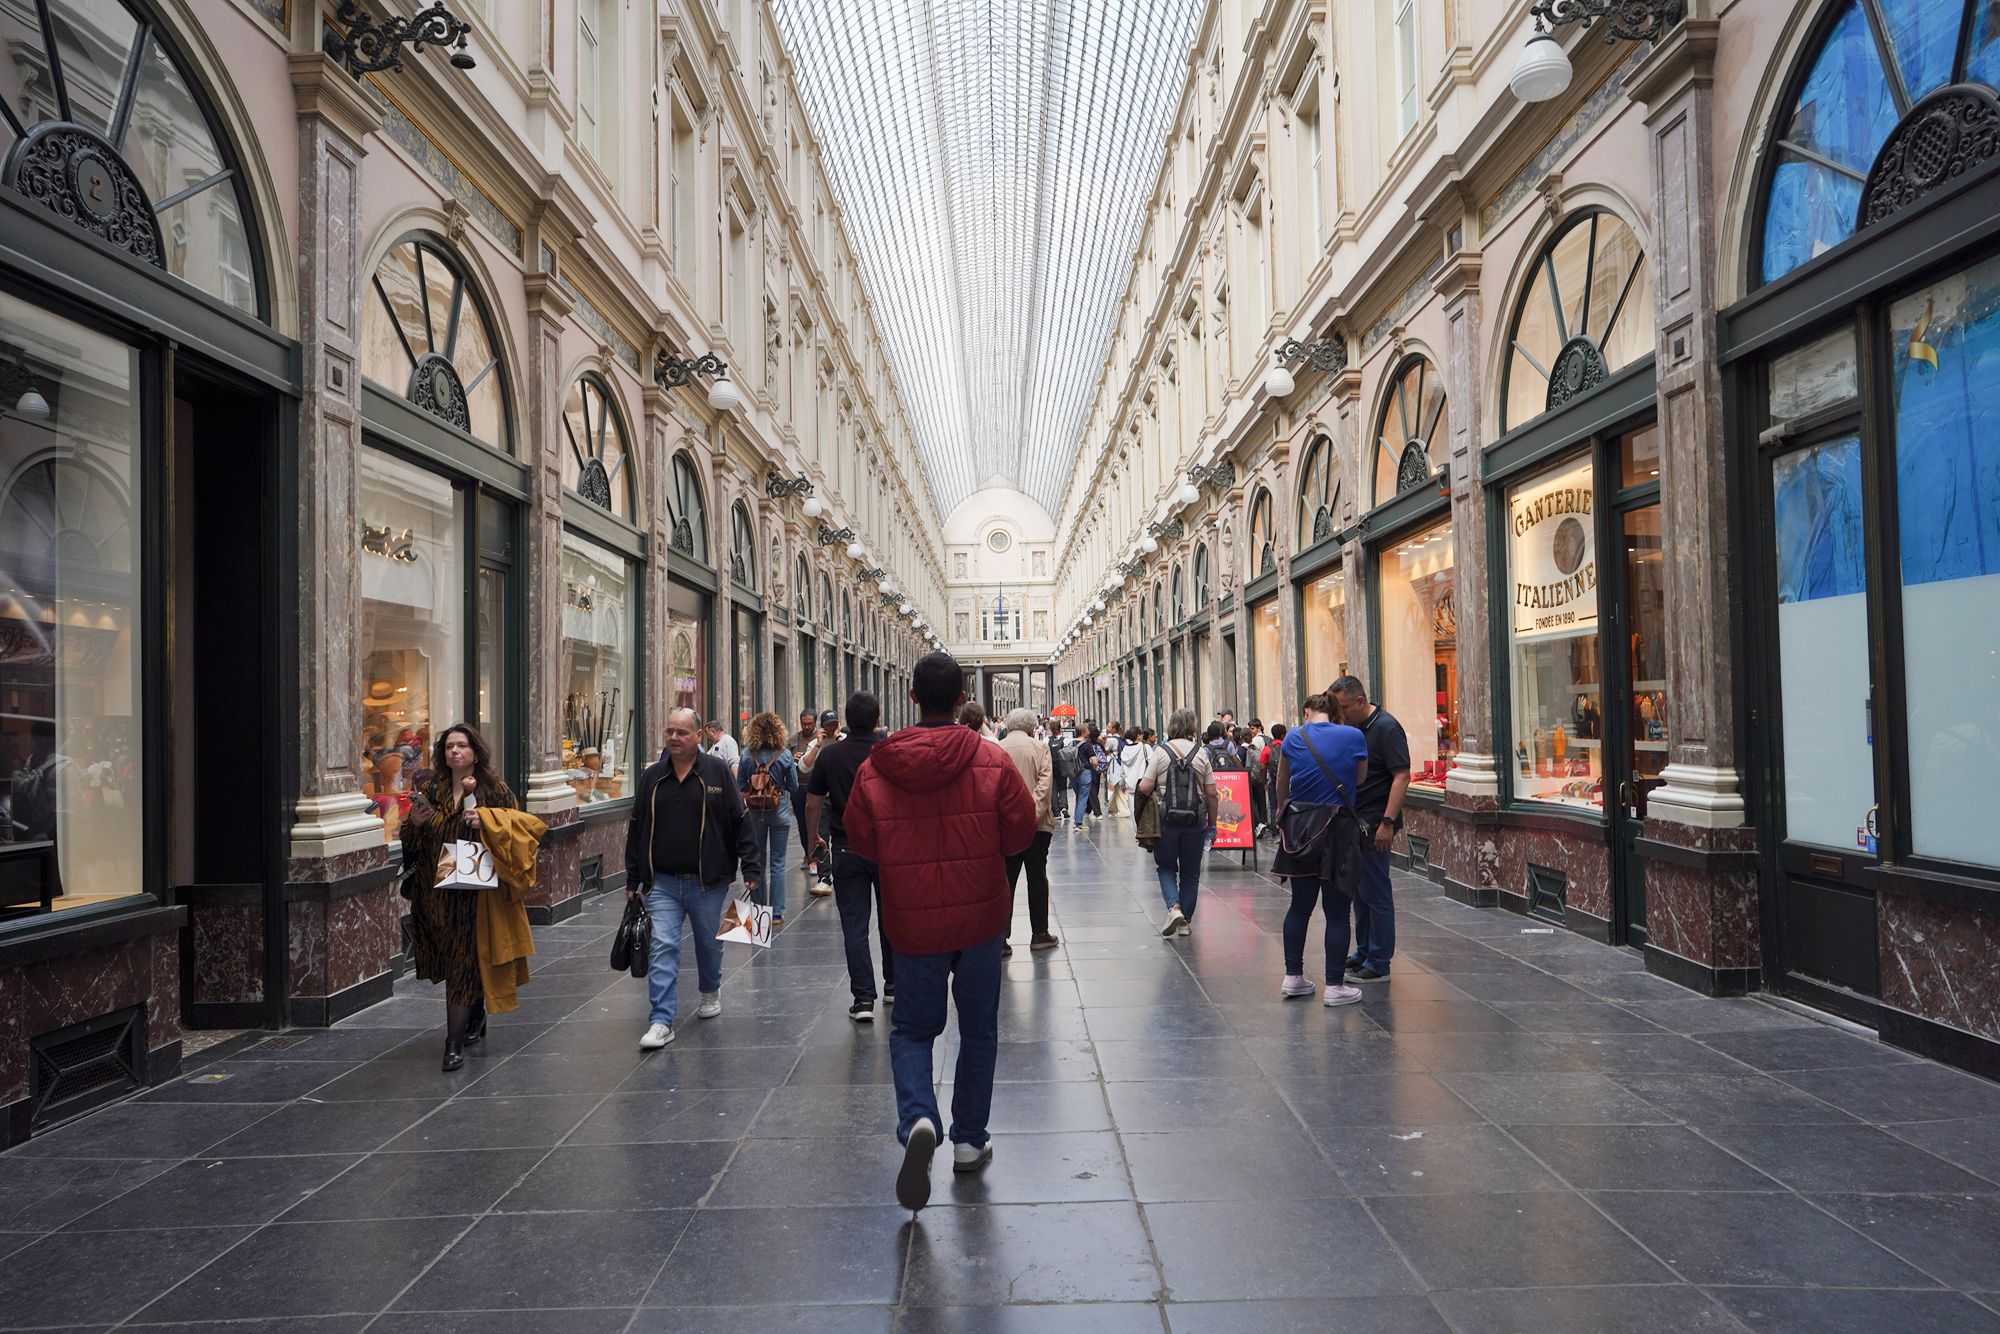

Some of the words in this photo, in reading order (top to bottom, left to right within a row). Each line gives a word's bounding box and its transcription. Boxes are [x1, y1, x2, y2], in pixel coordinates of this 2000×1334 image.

[90, 176, 102, 202] 2
[1515, 488, 1592, 537] GANTERIE
[1516, 562, 1596, 609] ITALIENNE
[1535, 613, 1554, 629] FONDÉE
[1555, 614, 1562, 626] EN
[1562, 611, 1576, 625] 1890
[458, 842, 497, 883] 30
[752, 903, 771, 944] 30
